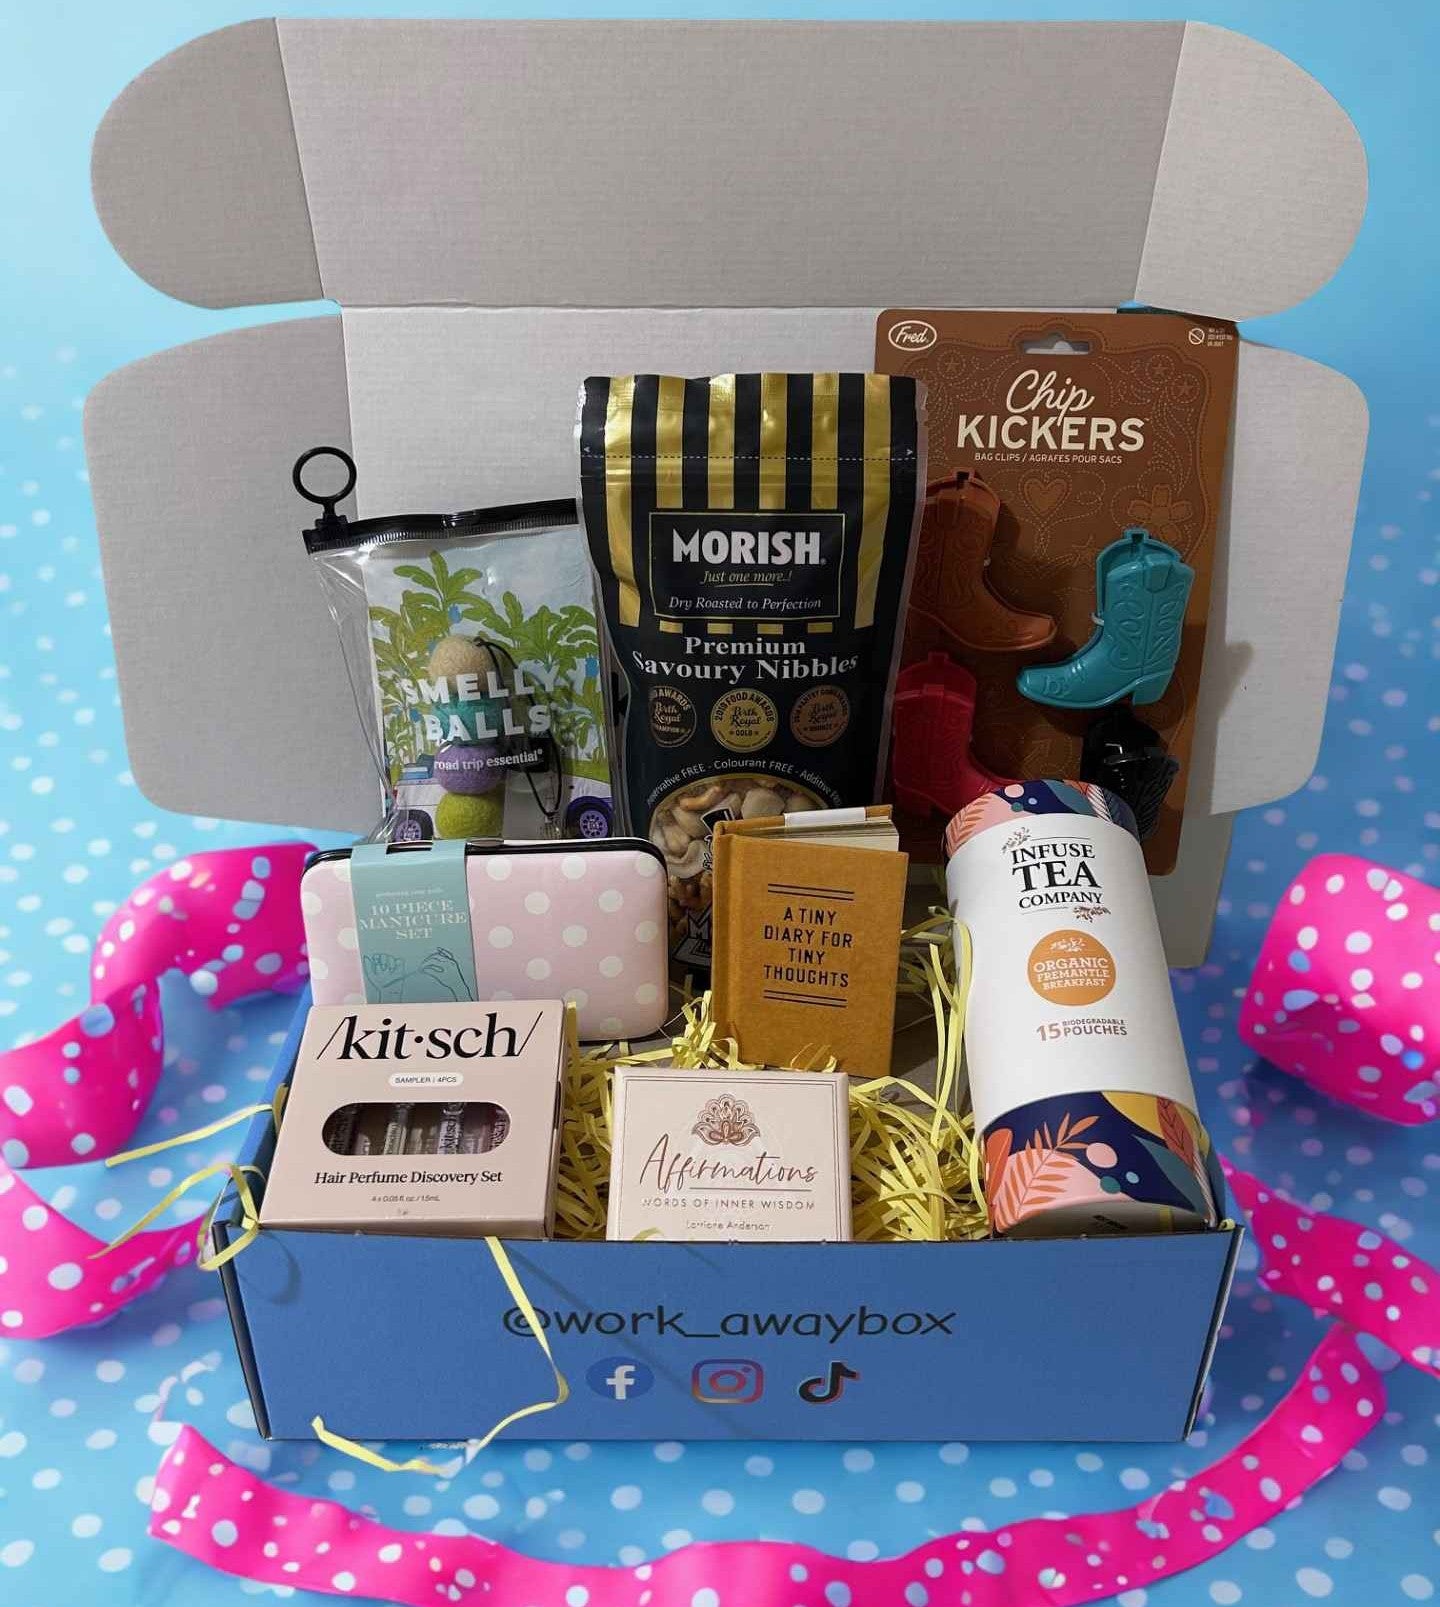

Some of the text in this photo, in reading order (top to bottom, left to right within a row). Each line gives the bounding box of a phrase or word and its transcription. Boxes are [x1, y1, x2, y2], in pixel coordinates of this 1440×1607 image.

[1005, 369, 1095, 426] Chip
[957, 414, 1145, 451] KICKERS
[974, 452, 993, 462] BAG
[995, 453, 1021, 463] CLIPS
[1029, 454, 1071, 464] AGRAFES
[1072, 454, 1097, 464] POUR
[1099, 455, 1122, 464] SACS
[672, 528, 821, 565] MORISH
[702, 570, 726, 583] Just
[728, 573, 751, 582] one
[669, 597, 822, 612] Dry Roasted to Perfection
[685, 636, 806, 655] Premium
[632, 651, 859, 685] Savoury Nibbles
[401, 659, 560, 705] SMELLY
[726, 691, 749, 706] FOOD
[423, 705, 550, 742] BALLS
[434, 760, 460, 772] road
[463, 759, 484, 771] trip
[681, 763, 706, 778] FREE
[713, 759, 766, 770] Colourant
[769, 761, 795, 775] FREE
[1011, 843, 1096, 864] INFUSE
[1012, 860, 1102, 893] TEA
[371, 900, 454, 916] 10 PIECE
[1019, 891, 1104, 910] COMPANY
[359, 911, 467, 930] MANICURE
[783, 907, 837, 926] A TINY
[396, 928, 433, 940] SET
[764, 925, 853, 948] DIARY FOR
[788, 948, 826, 964] TINY
[1033, 957, 1109, 973] ORGANIC
[763, 965, 849, 988] THOUGHTS
[1037, 969, 1110, 983] FREMANTLE
[1042, 979, 1106, 990] BREAKFAST
[1036, 1023, 1062, 1041] 15
[1063, 1025, 1128, 1037] POUCHES
[394, 1076, 431, 1084] SAMPLER
[639, 1133, 819, 1193] Affirmations
[314, 1170, 503, 1185] Hair Perfume Discovery Set
[642, 1199, 815, 1210] WORDS OF INNER WISDOM
[726, 1221, 771, 1230] Anderson
[502, 1305, 957, 1344] @work_awaybox
